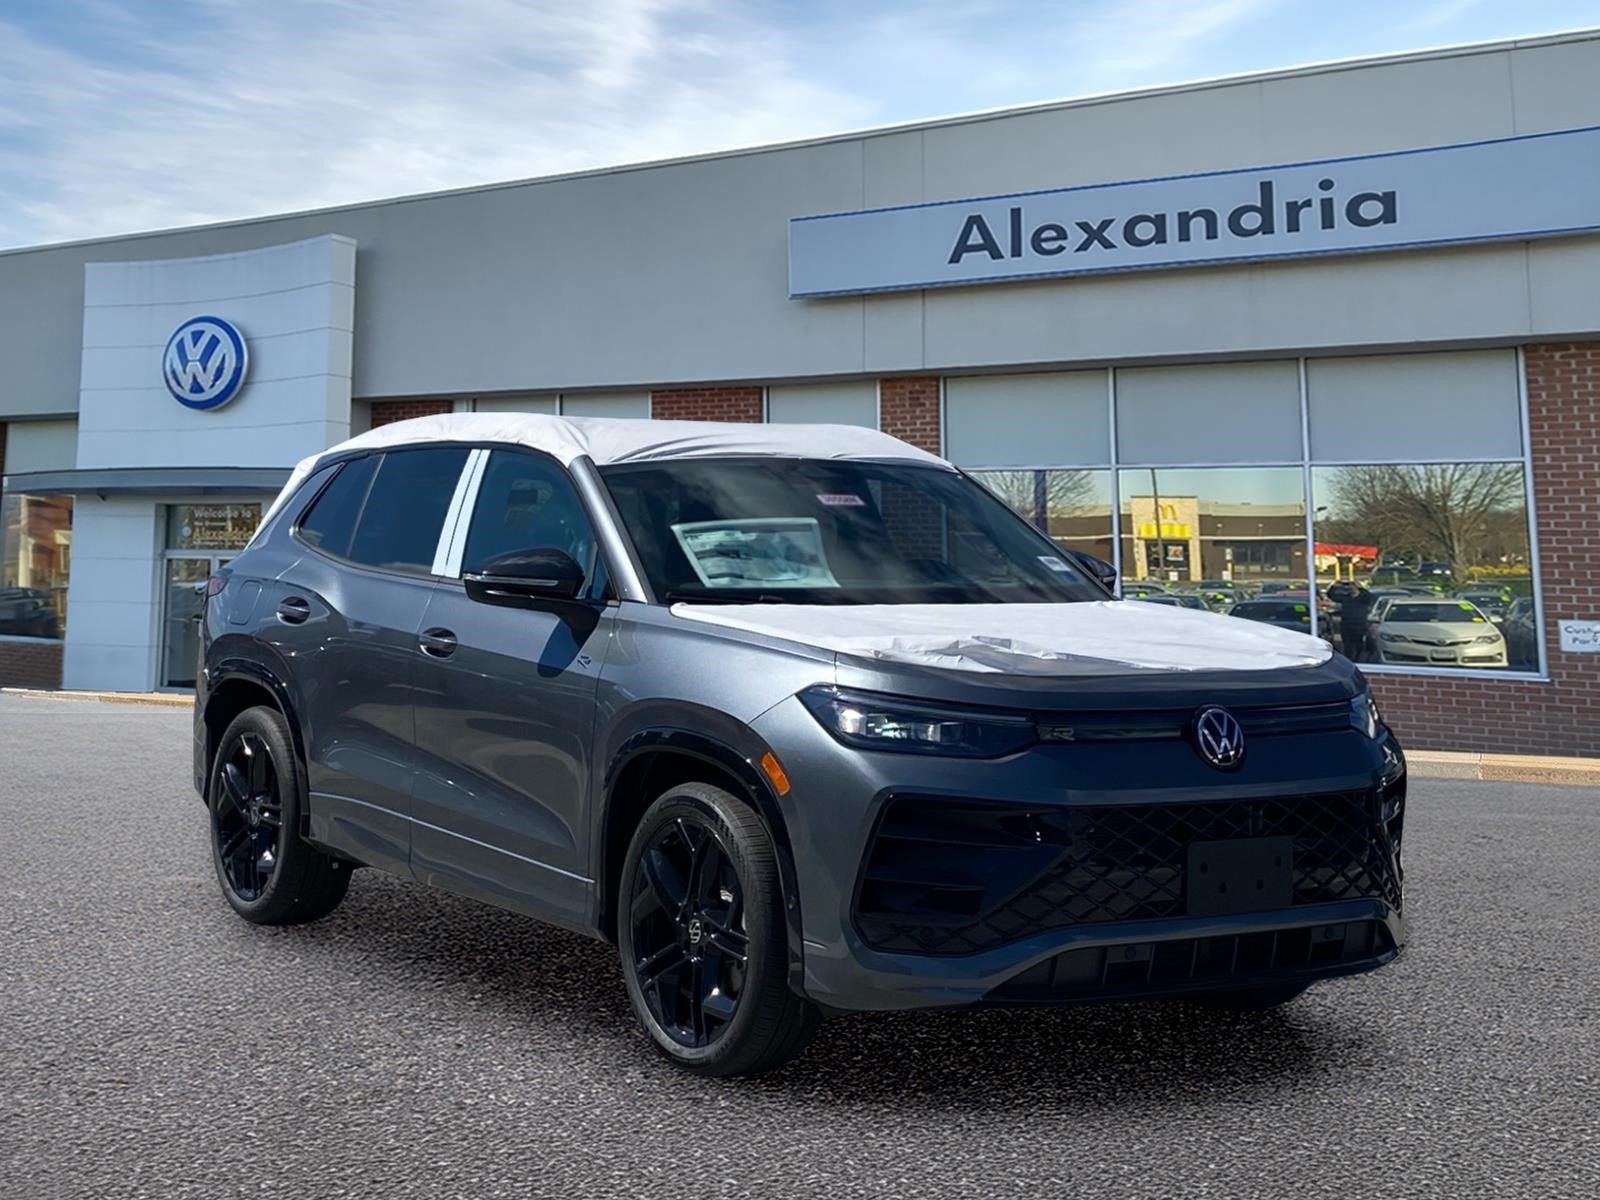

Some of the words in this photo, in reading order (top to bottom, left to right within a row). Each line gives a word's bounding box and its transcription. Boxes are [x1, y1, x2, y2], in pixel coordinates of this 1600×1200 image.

[947, 178, 1398, 265] Alexandria
[164, 320, 239, 402] VW
[1199, 709, 1244, 765] VW
